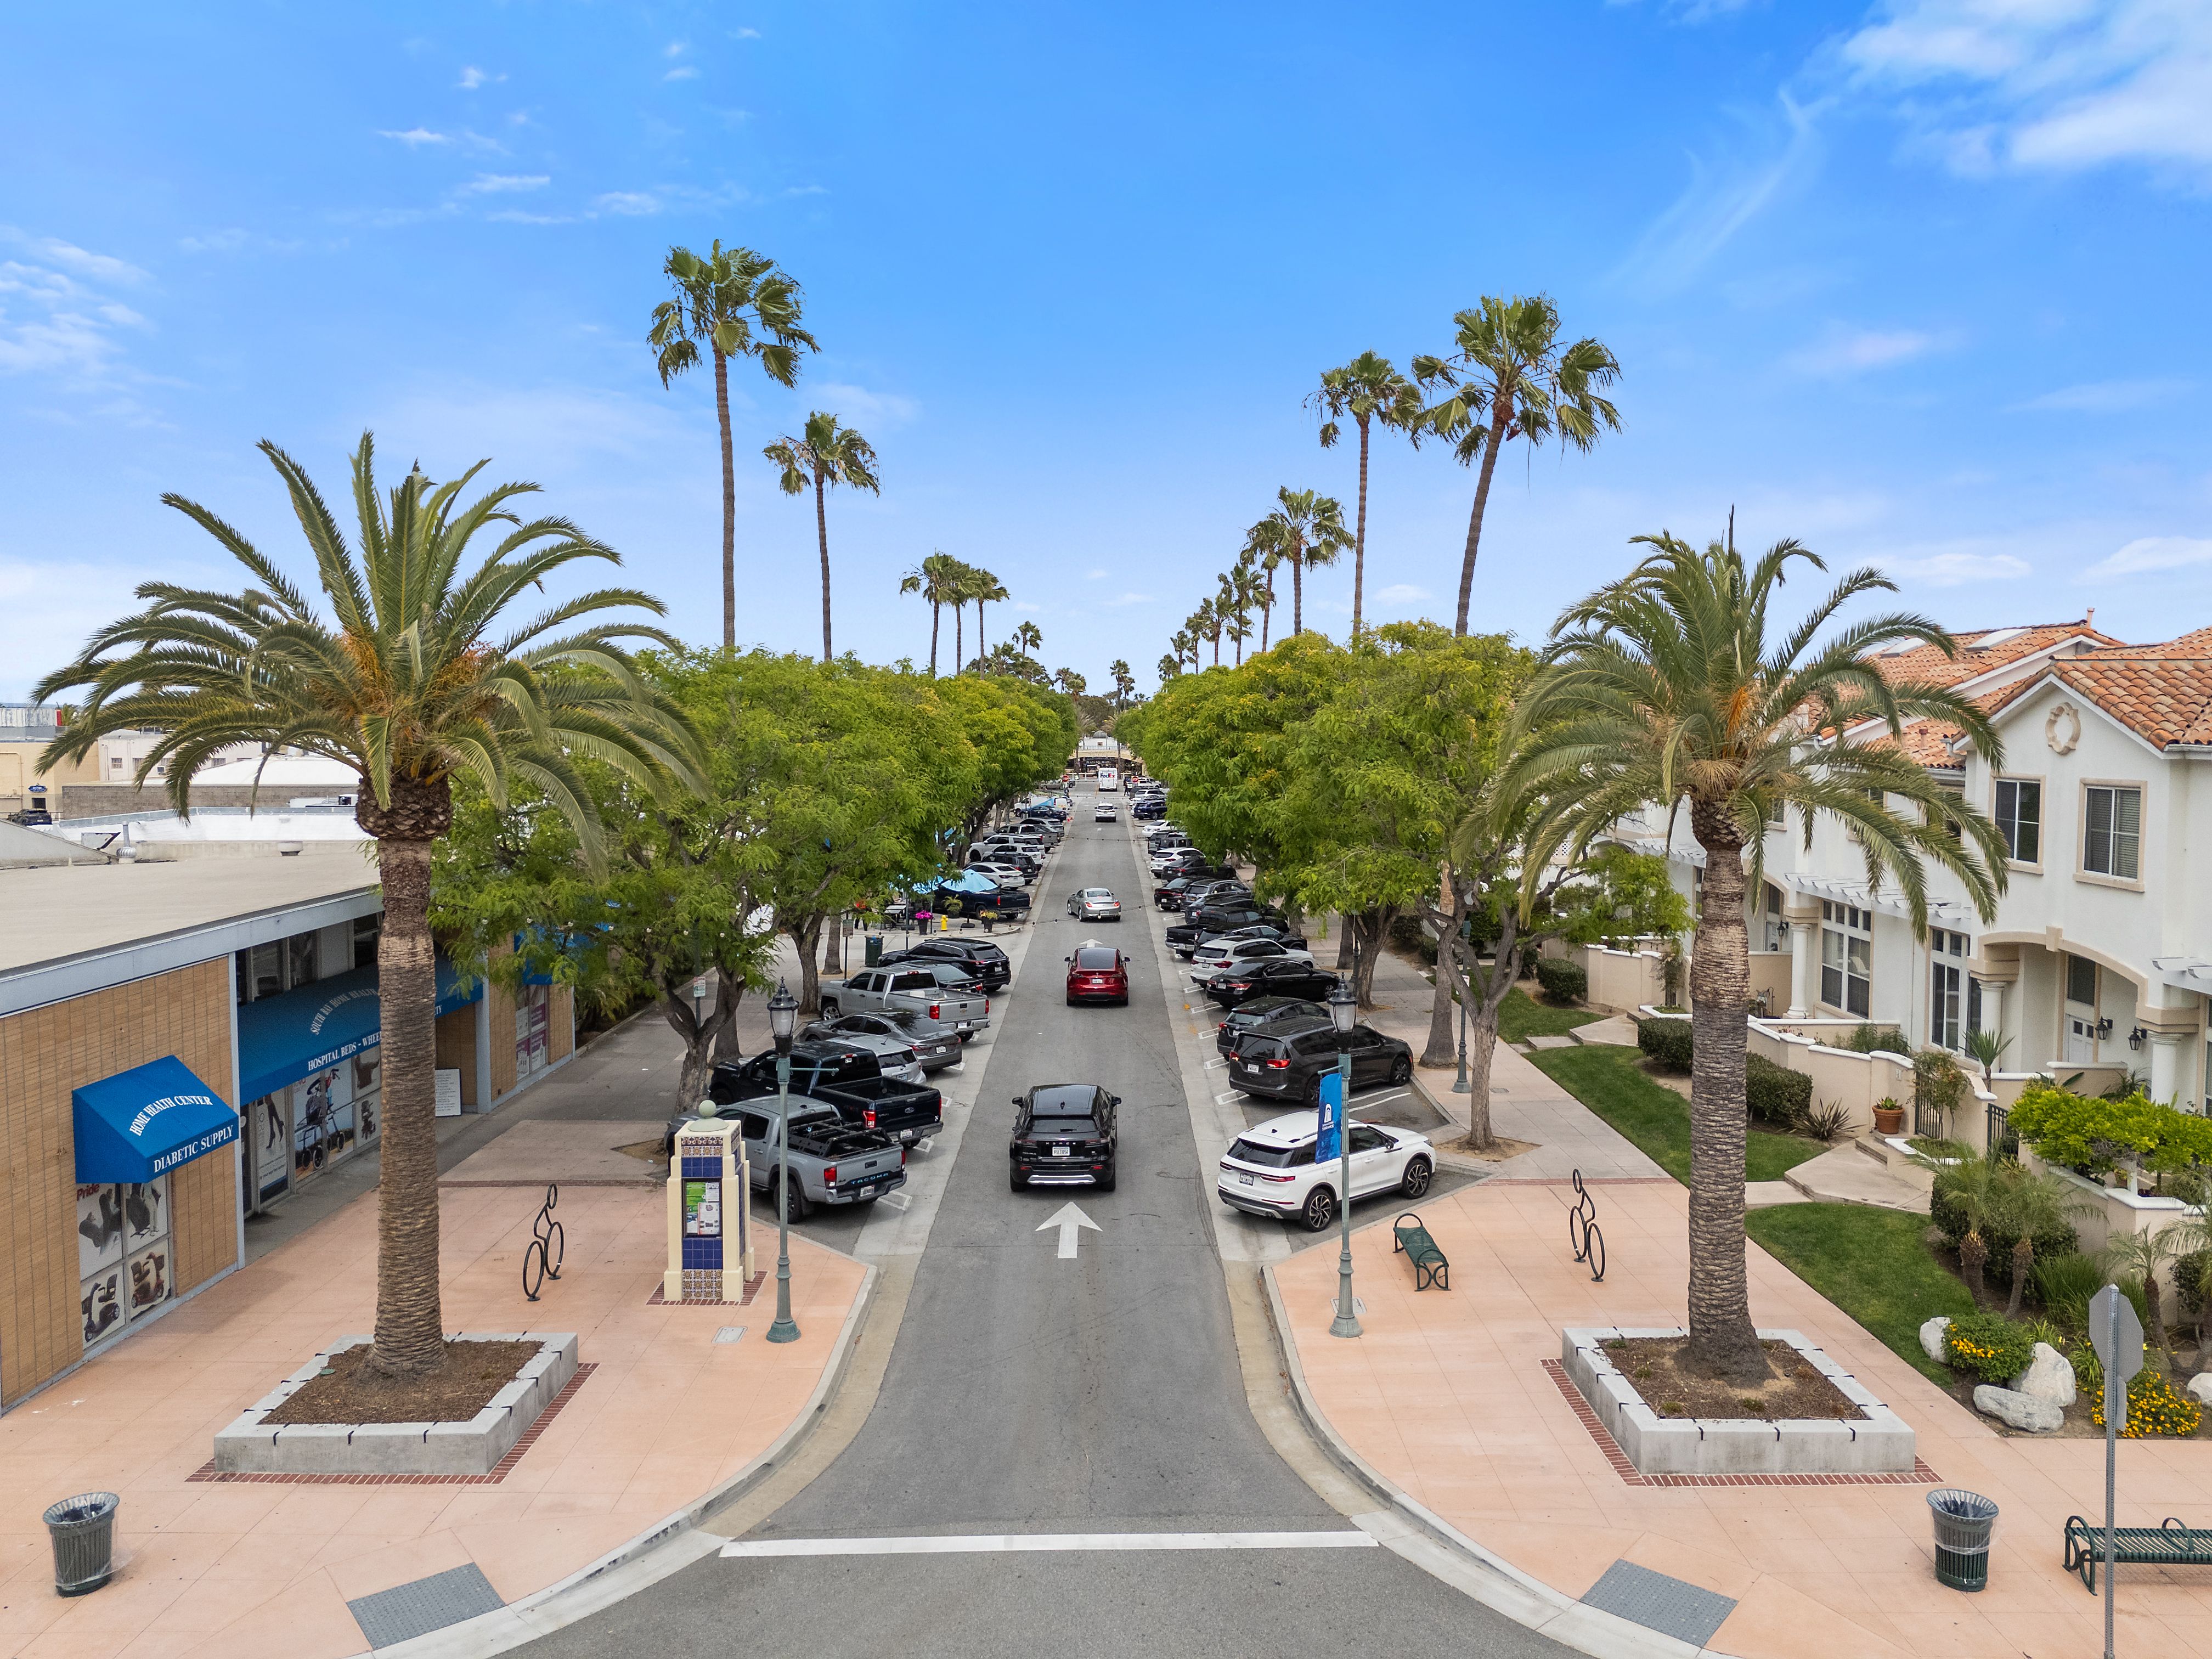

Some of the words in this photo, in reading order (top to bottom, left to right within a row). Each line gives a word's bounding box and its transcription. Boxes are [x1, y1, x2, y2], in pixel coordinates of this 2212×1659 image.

[310, 1013, 325, 1035] SOUTH
[320, 1005, 333, 1015] BAY
[329, 994, 351, 1007] HOME
[348, 988, 378, 998] HEALTH
[308, 1049, 340, 1071] HOSPITAL
[341, 1042, 357, 1057] BEDS
[129, 1111, 151, 1137] HOME
[143, 1097, 176, 1117] HEALTH
[173, 1096, 213, 1105] CENTER
[154, 1142, 198, 1173] DIABETIC
[201, 1125, 234, 1150] SUPPLY
[76, 1184, 99, 1201] Pride
[851, 1172, 889, 1184] TACOMA
